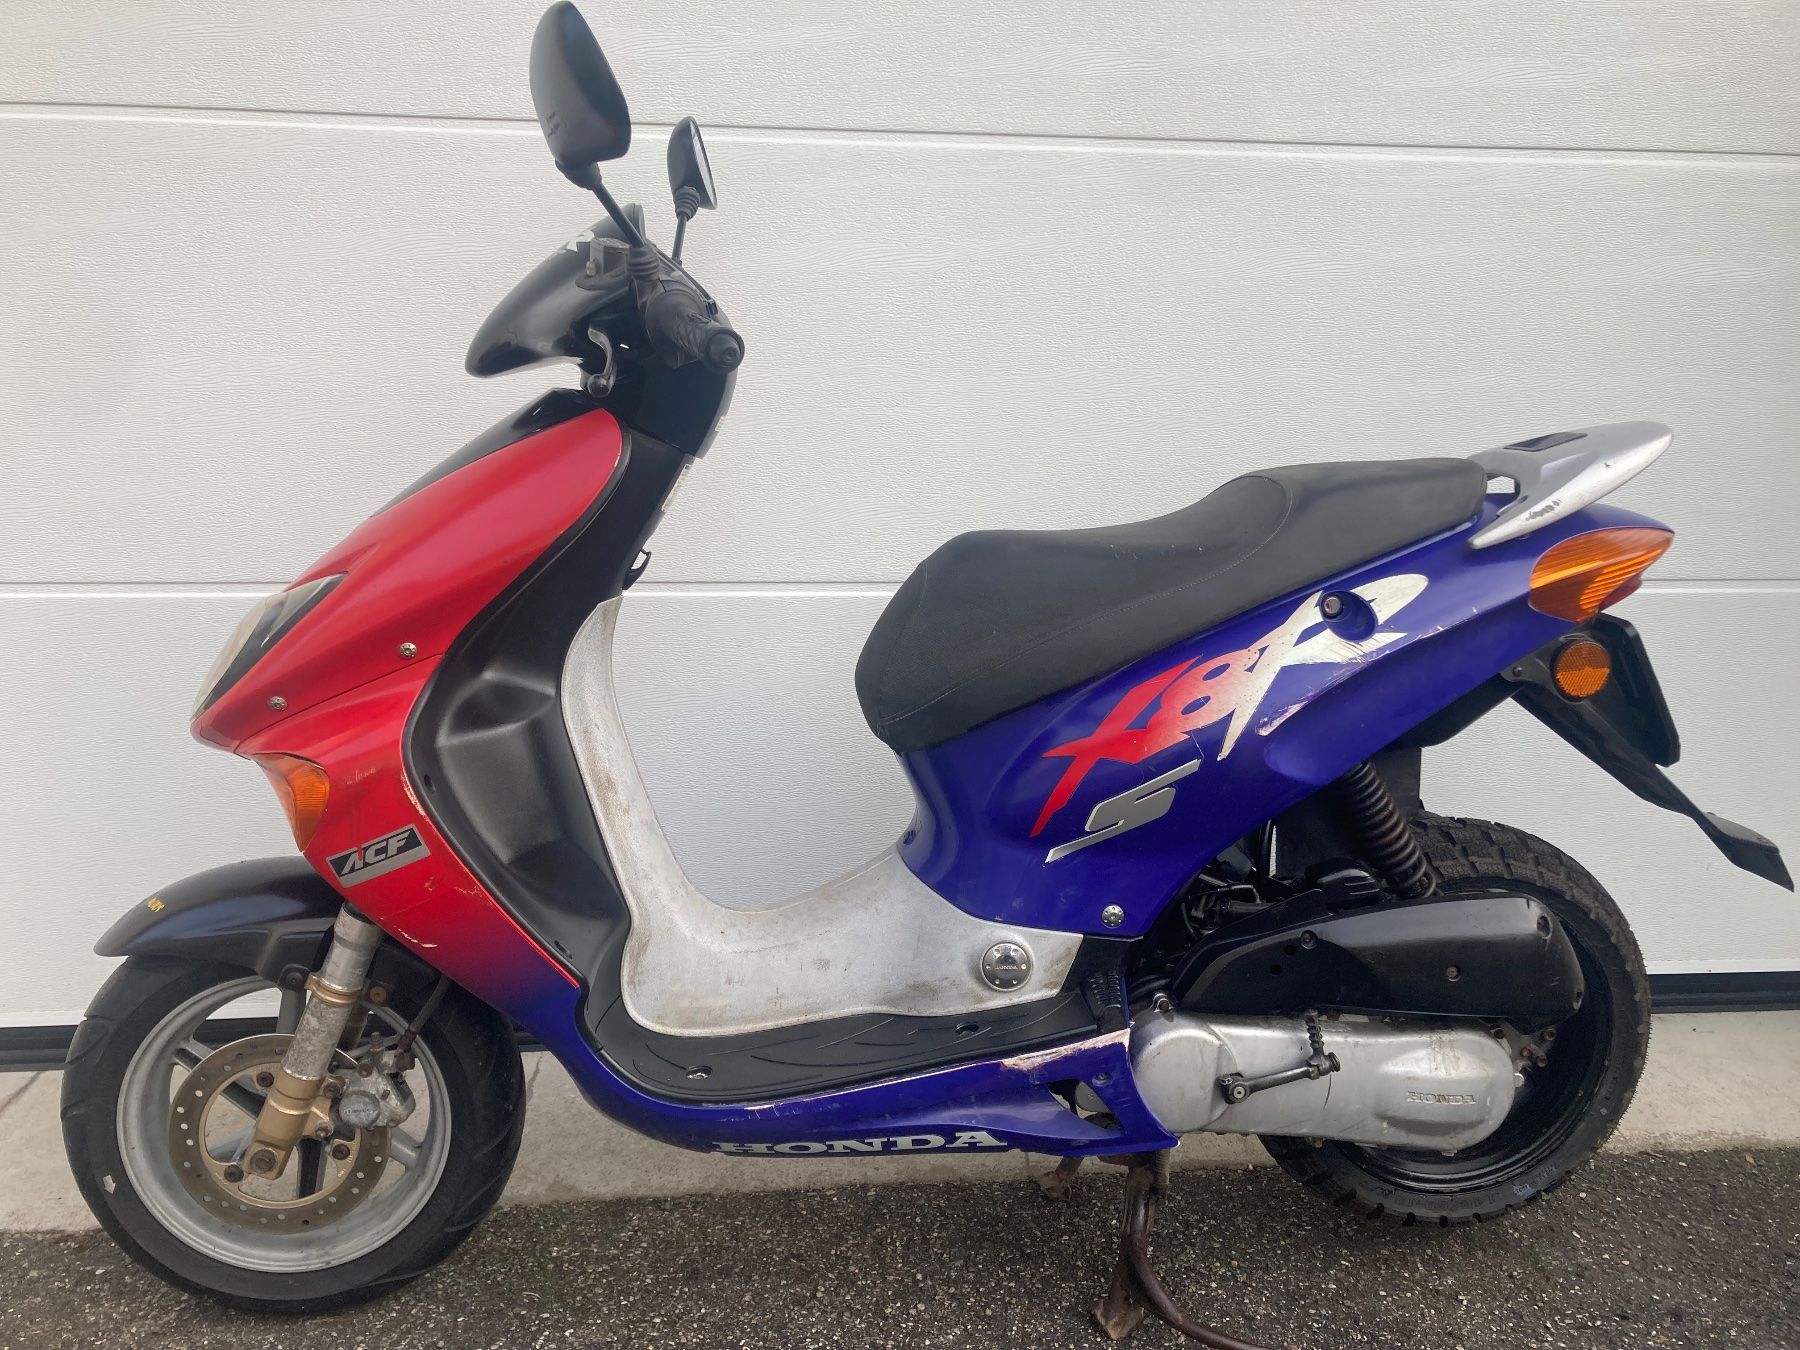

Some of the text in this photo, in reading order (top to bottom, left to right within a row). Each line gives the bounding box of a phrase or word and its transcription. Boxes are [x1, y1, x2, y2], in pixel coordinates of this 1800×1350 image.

[1044, 758, 1201, 864] S
[340, 830, 411, 876] ACF
[1406, 1090, 1477, 1105] HONDA
[711, 1131, 1008, 1154] HONDA
